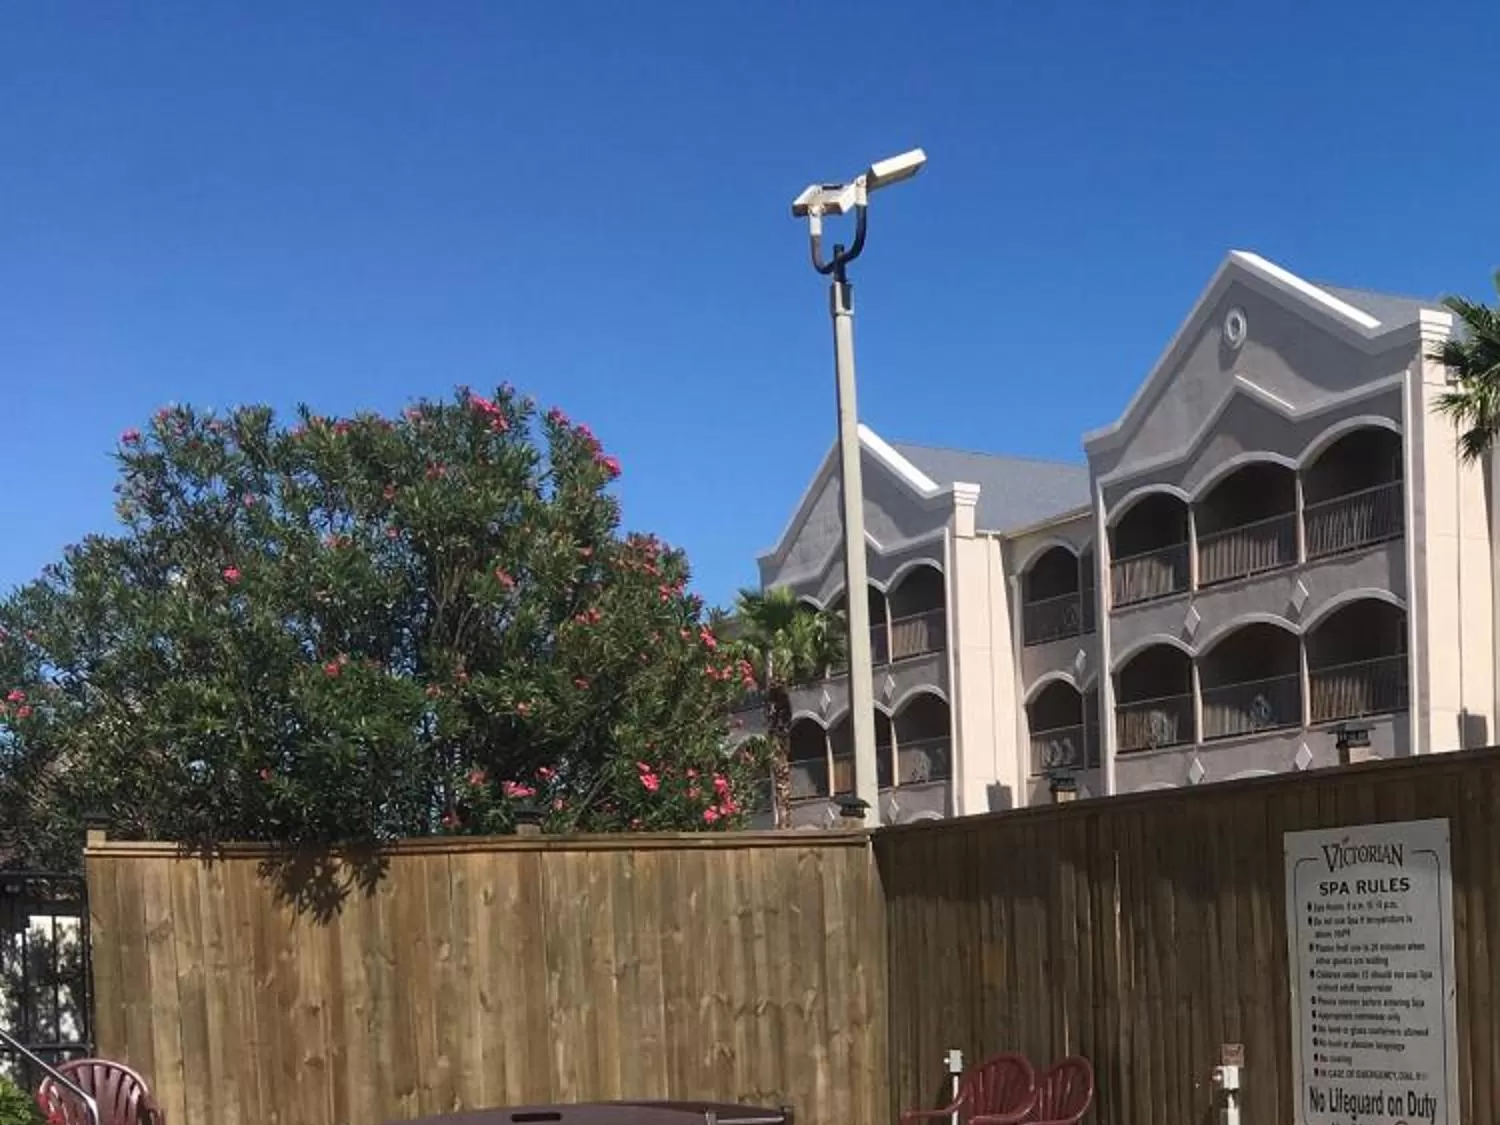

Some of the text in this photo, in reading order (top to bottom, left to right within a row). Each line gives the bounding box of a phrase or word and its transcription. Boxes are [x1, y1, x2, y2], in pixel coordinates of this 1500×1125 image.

[1319, 877, 1410, 896] SPA RULES
[1309, 1086, 1437, 1125] No Lifeguard on Duty
